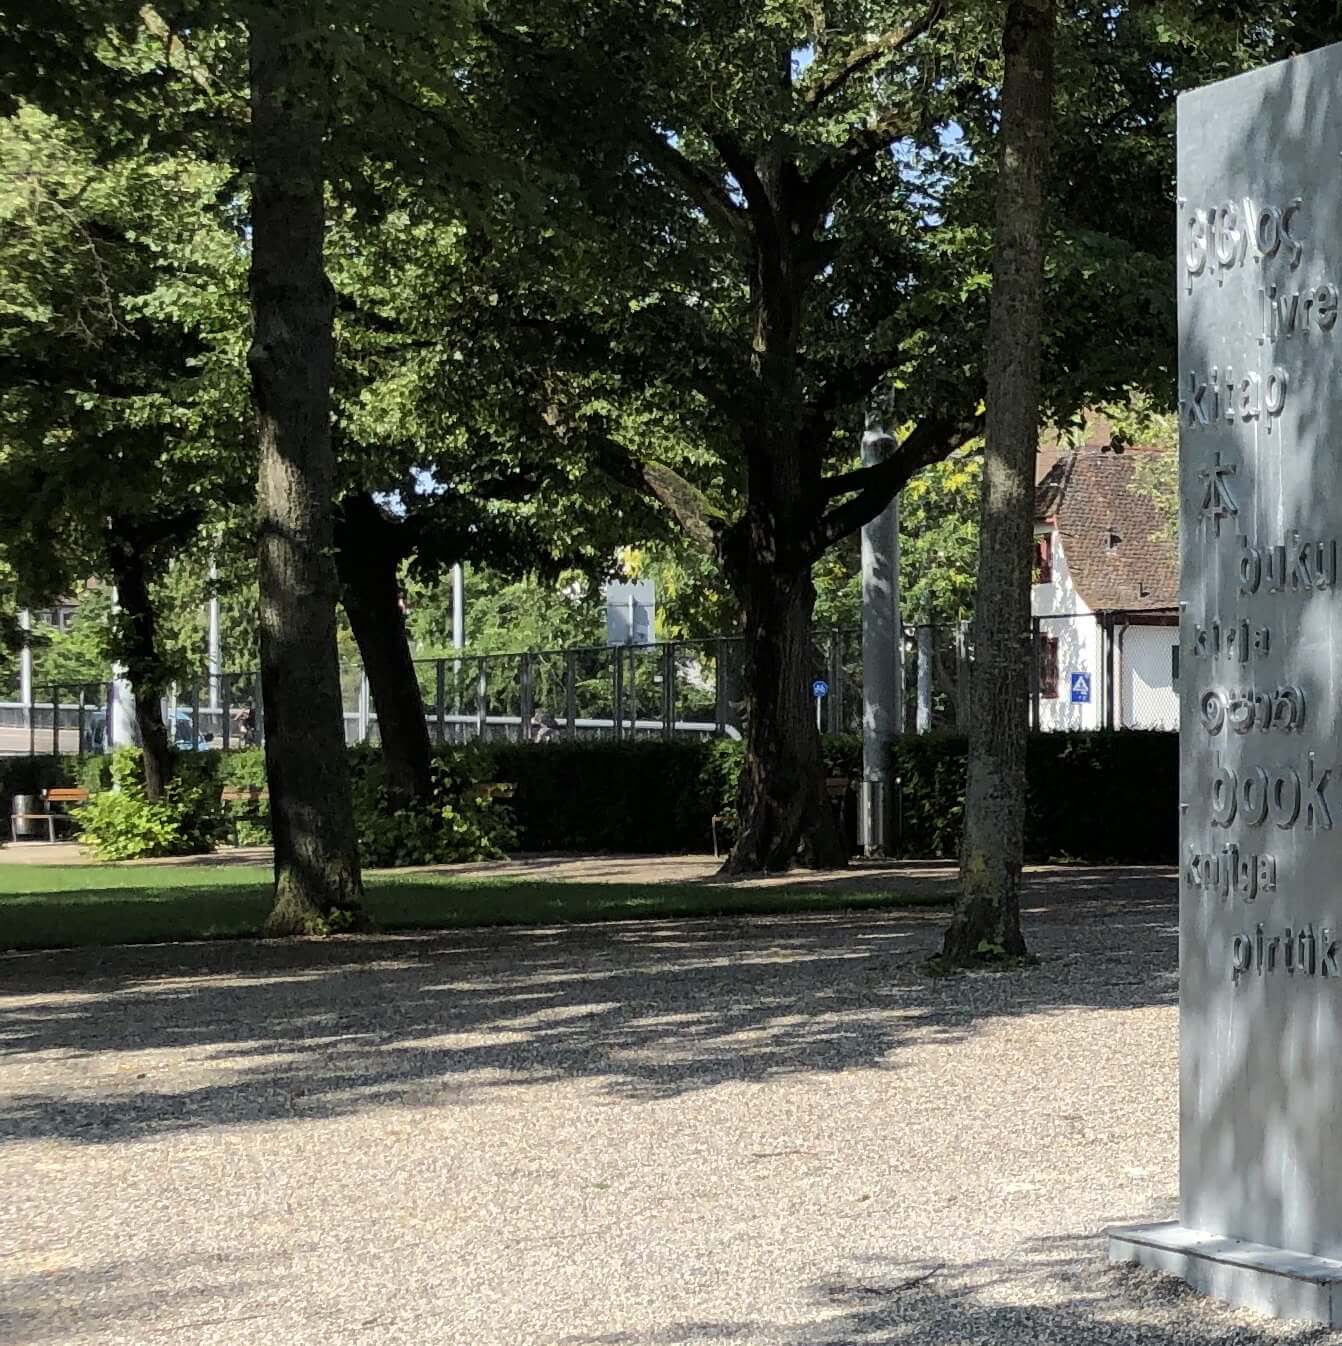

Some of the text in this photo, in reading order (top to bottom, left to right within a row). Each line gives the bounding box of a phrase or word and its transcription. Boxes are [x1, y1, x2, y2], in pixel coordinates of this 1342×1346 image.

[1256, 282, 1340, 346] livre
[1183, 365, 1289, 435] kitap
[1199, 451, 1239, 538] 本
[1237, 529, 1337, 596] buku
[1193, 617, 1270, 664] kirja
[1210, 750, 1334, 831] book
[1185, 842, 1278, 905] knjiga
